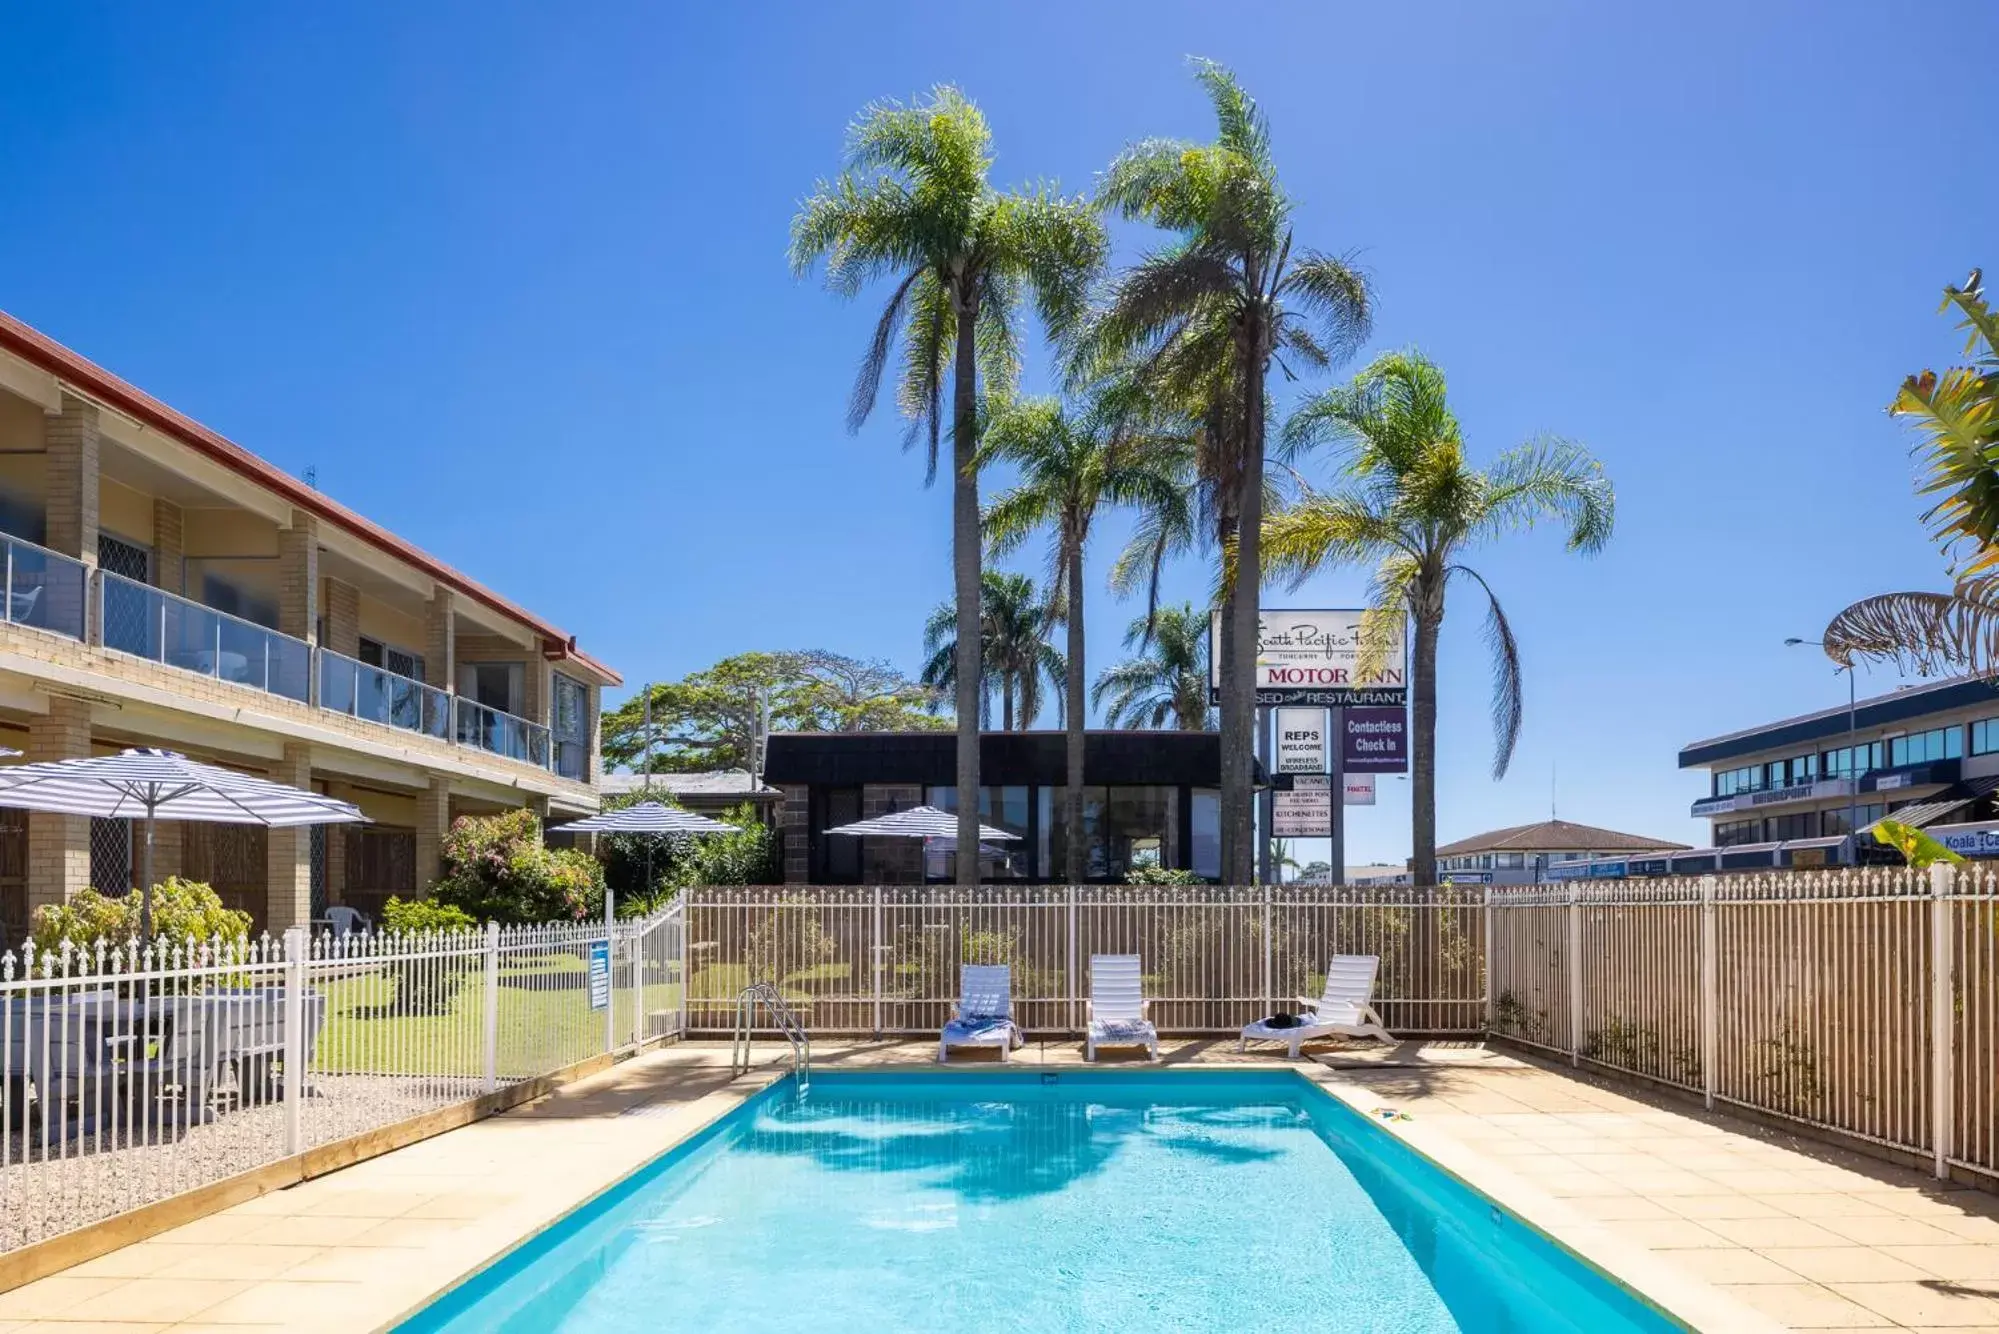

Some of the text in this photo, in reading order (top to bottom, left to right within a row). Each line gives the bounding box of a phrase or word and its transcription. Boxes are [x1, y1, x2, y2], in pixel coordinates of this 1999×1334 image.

[1292, 624, 1349, 660] Pacific
[1268, 668, 1348, 683] MOTOR
[1306, 692, 1402, 704] RESTAURANT
[1348, 720, 1402, 733] Contactless
[1284, 731, 1319, 741] REPS
[1281, 743, 1322, 751] WELCOME
[1355, 738, 1385, 752] Check
[1275, 810, 1328, 818] KITCHENETTES
[1945, 835, 1976, 849] Koala
